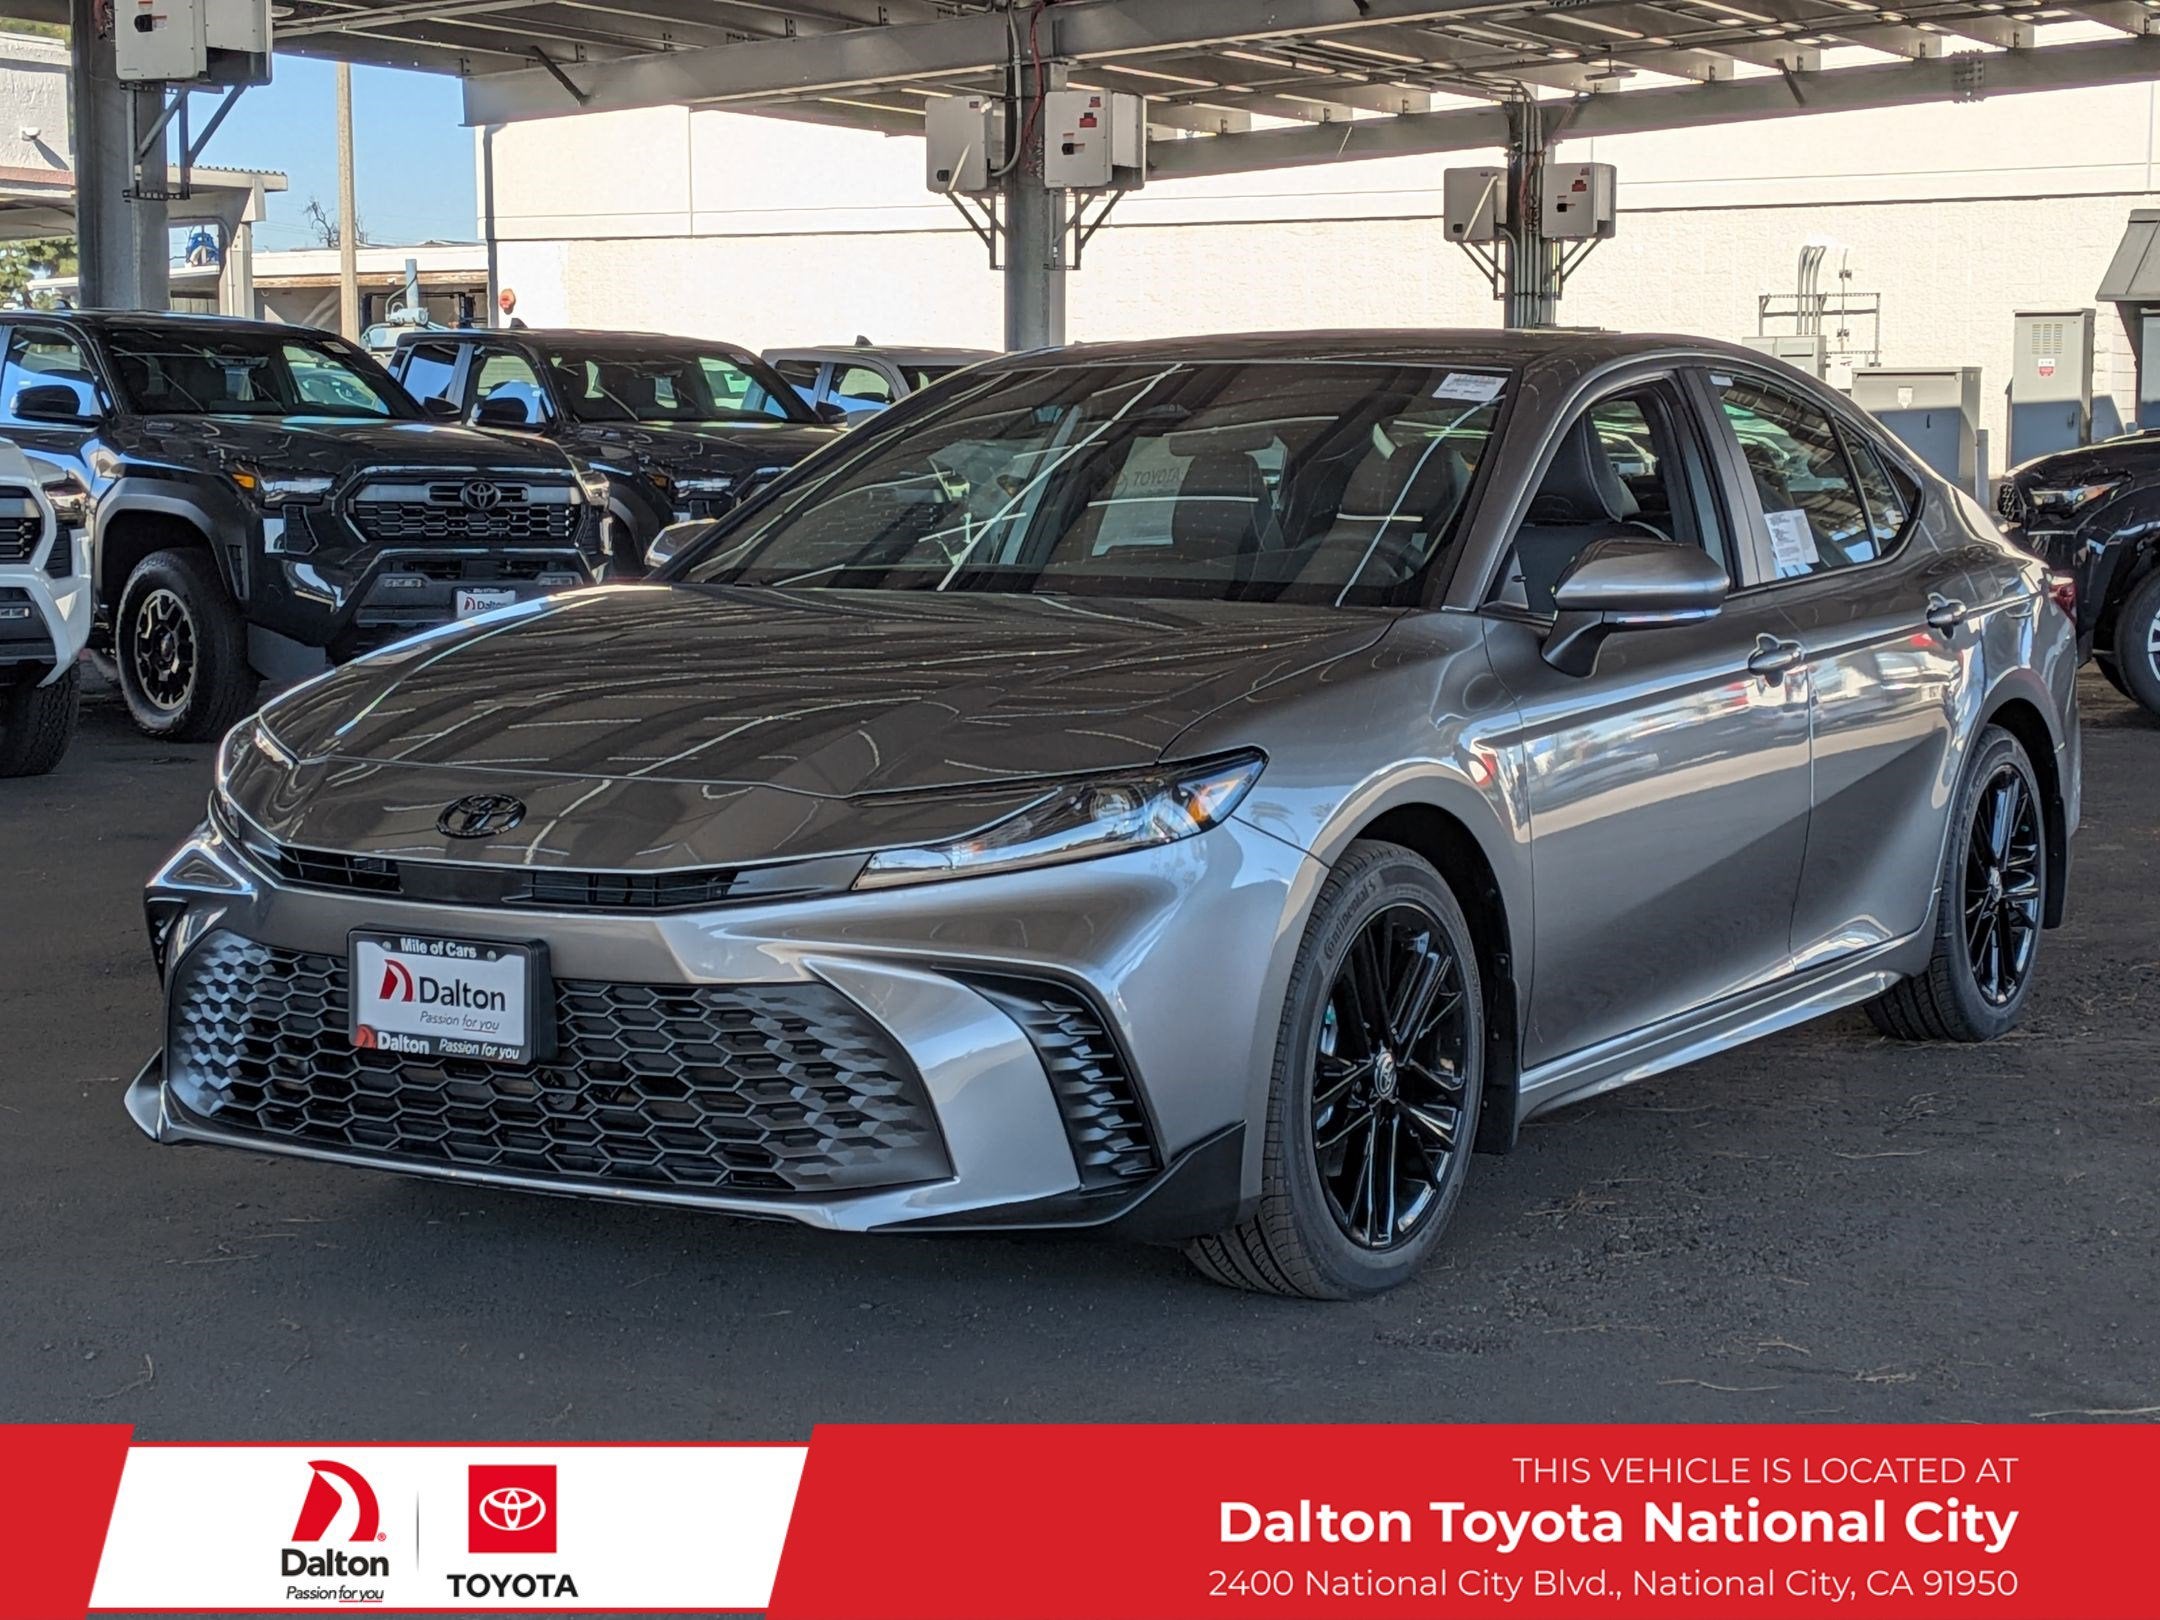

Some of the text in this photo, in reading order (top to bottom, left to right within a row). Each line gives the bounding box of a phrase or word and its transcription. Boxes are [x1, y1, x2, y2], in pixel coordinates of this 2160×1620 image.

[400, 937, 477, 958] Mile of Cars
[419, 977, 506, 1012] Dalton
[420, 1010, 500, 1032] Passion for you
[377, 1031, 520, 1060] Dalton Passion for you
